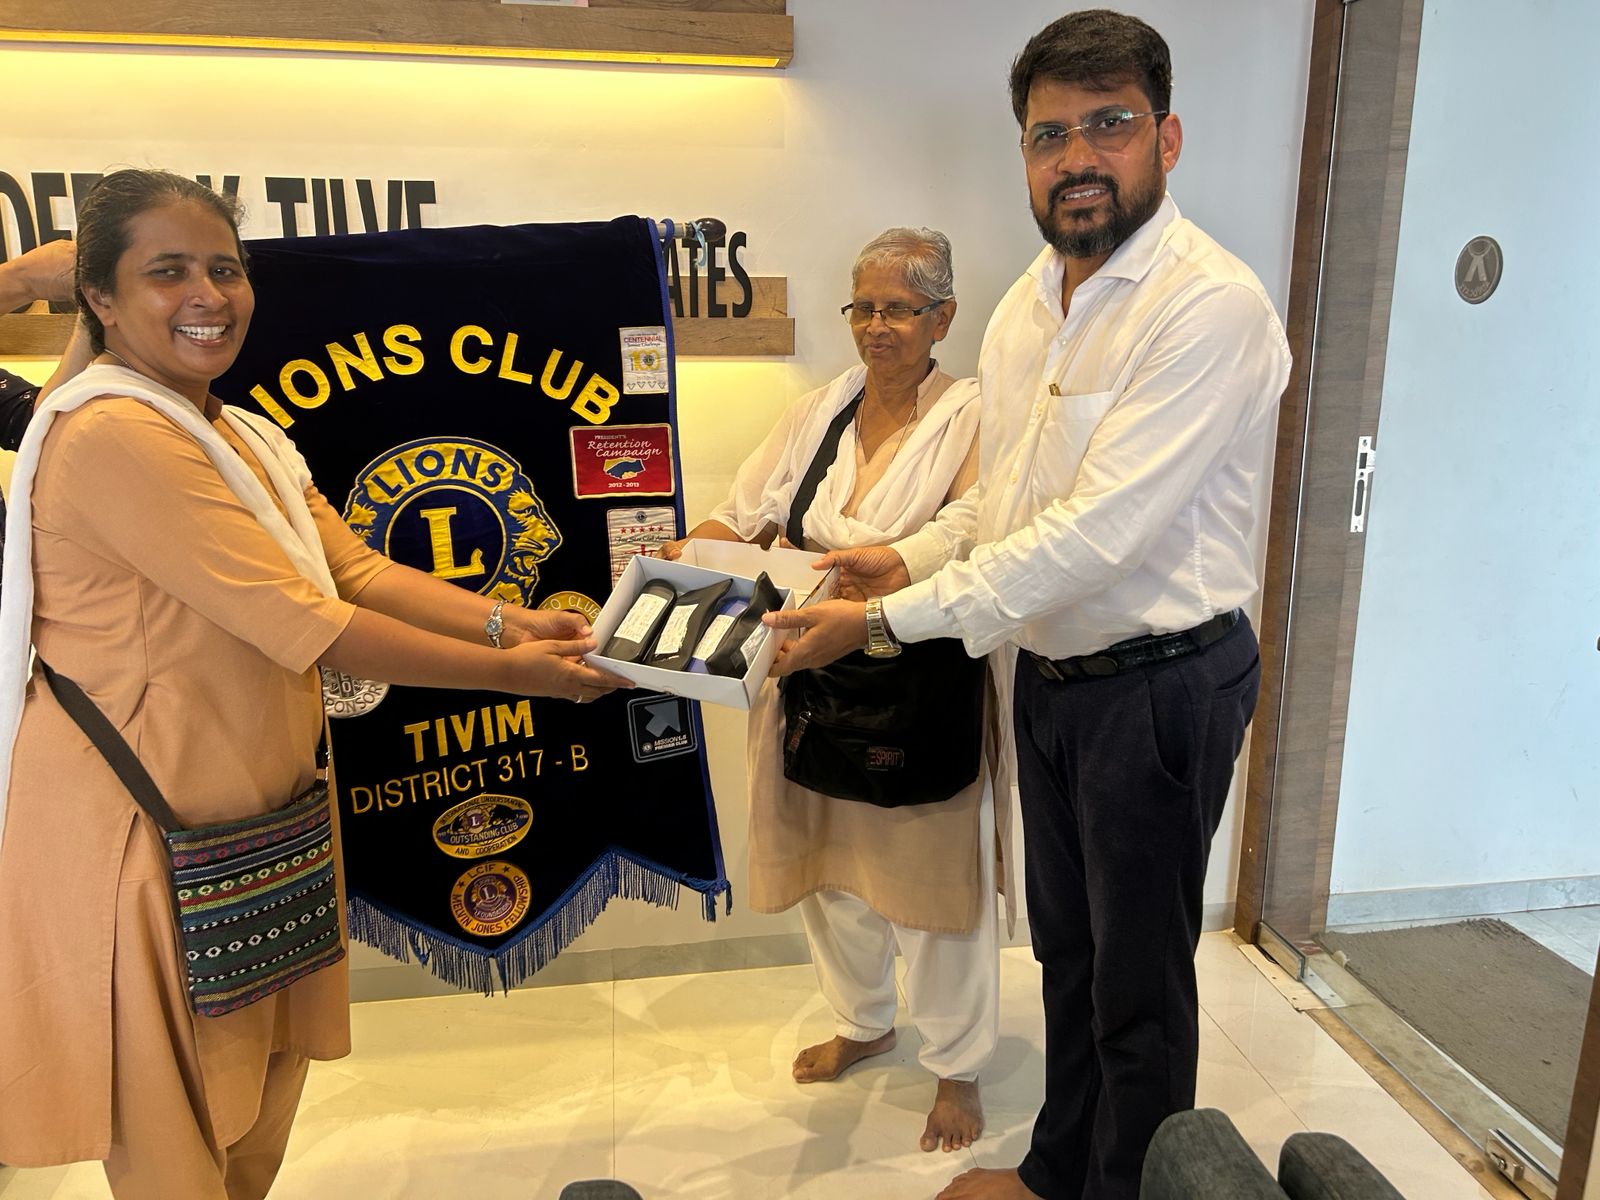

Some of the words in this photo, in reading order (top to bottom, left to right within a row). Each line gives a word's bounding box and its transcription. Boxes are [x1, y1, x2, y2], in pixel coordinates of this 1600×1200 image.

[663, 232, 753, 318] ATES
[623, 335, 663, 343] CENTENNIAL
[250, 324, 425, 429] IONS
[449, 325, 620, 424] CLUB
[587, 438, 652, 450] Retention
[595, 447, 663, 461] Campaign
[373, 449, 507, 498] LIONS
[420, 506, 485, 580] L
[568, 595, 601, 619] CLUB
[324, 684, 383, 714] PONSOR
[404, 700, 534, 763] TIVIM
[350, 758, 488, 814] DISTRICT
[497, 749, 544, 782] 317
[570, 744, 589, 772] B
[450, 829, 500, 844] OUTSTANDING
[500, 823, 519, 835] CLUB
[454, 847, 470, 856] AND
[475, 834, 518, 856] COOPERATION
[467, 863, 497, 878] LCIF
[452, 893, 472, 928] MELVIN
[471, 923, 503, 934] JONES
[504, 875, 529, 928] FELLOWSHIP
